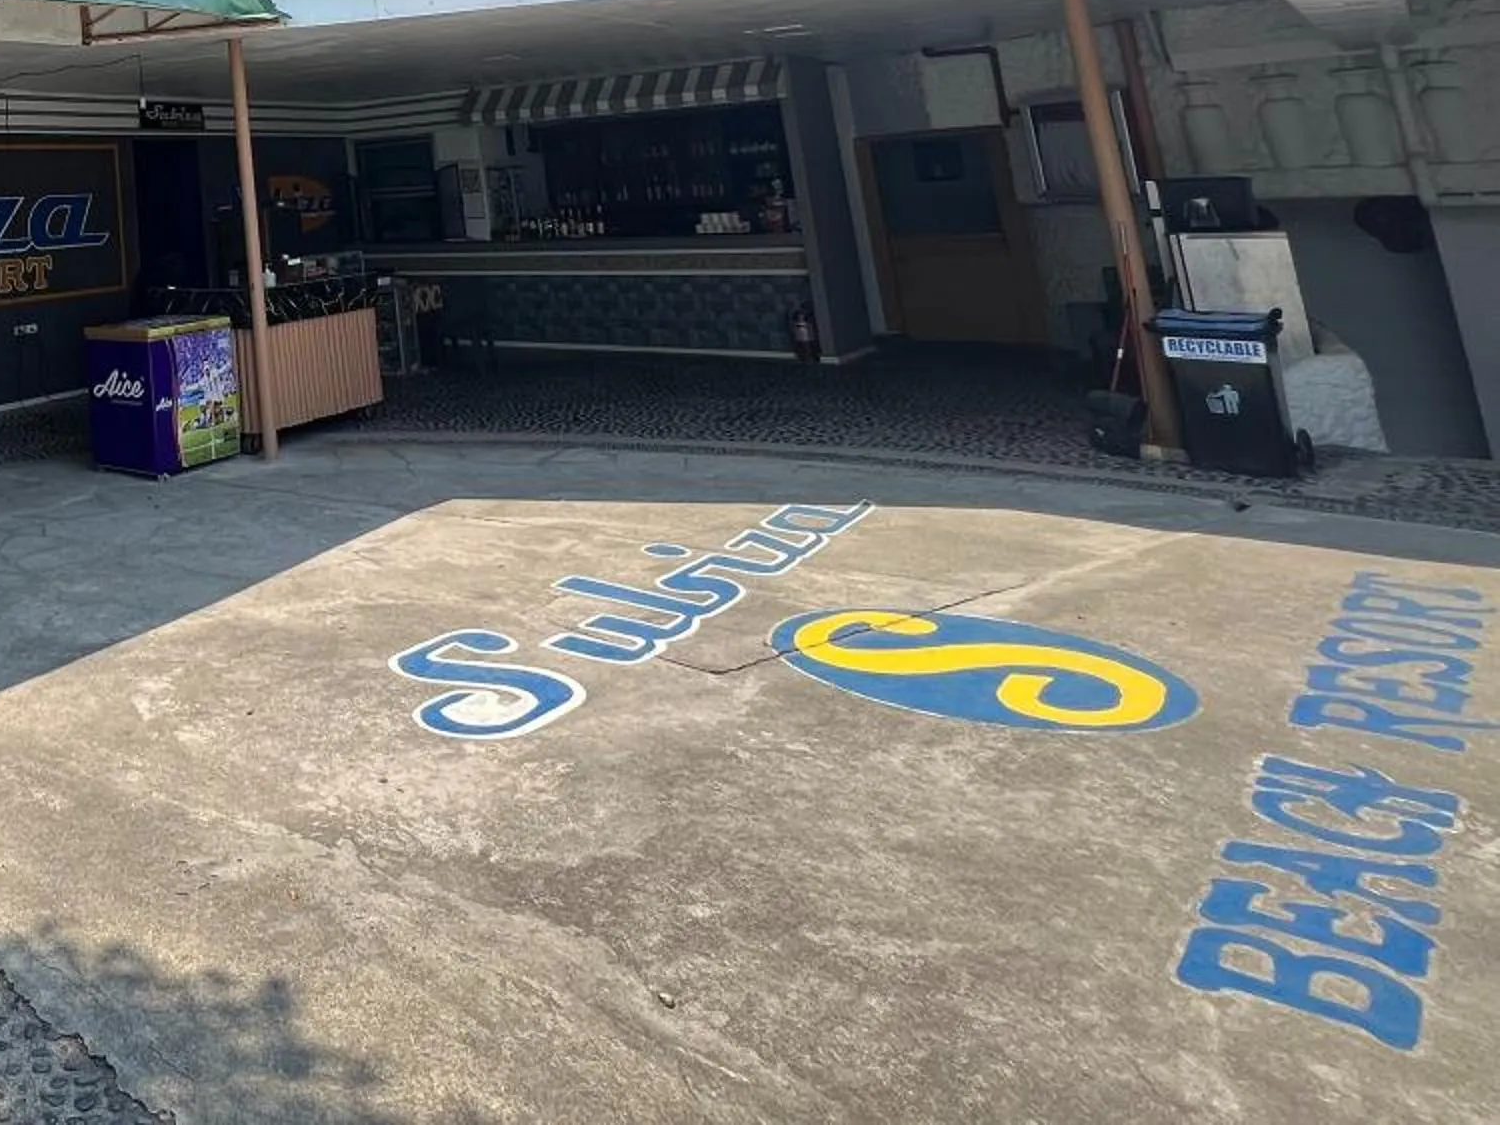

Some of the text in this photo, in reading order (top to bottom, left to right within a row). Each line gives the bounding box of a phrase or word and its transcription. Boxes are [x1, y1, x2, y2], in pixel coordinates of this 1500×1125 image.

[93, 368, 145, 399] Aice
[1168, 339, 1262, 356] RECYCLABLE
[389, 499, 876, 740] Subiza
[1171, 569, 1500, 1053] BEACH RESORT
